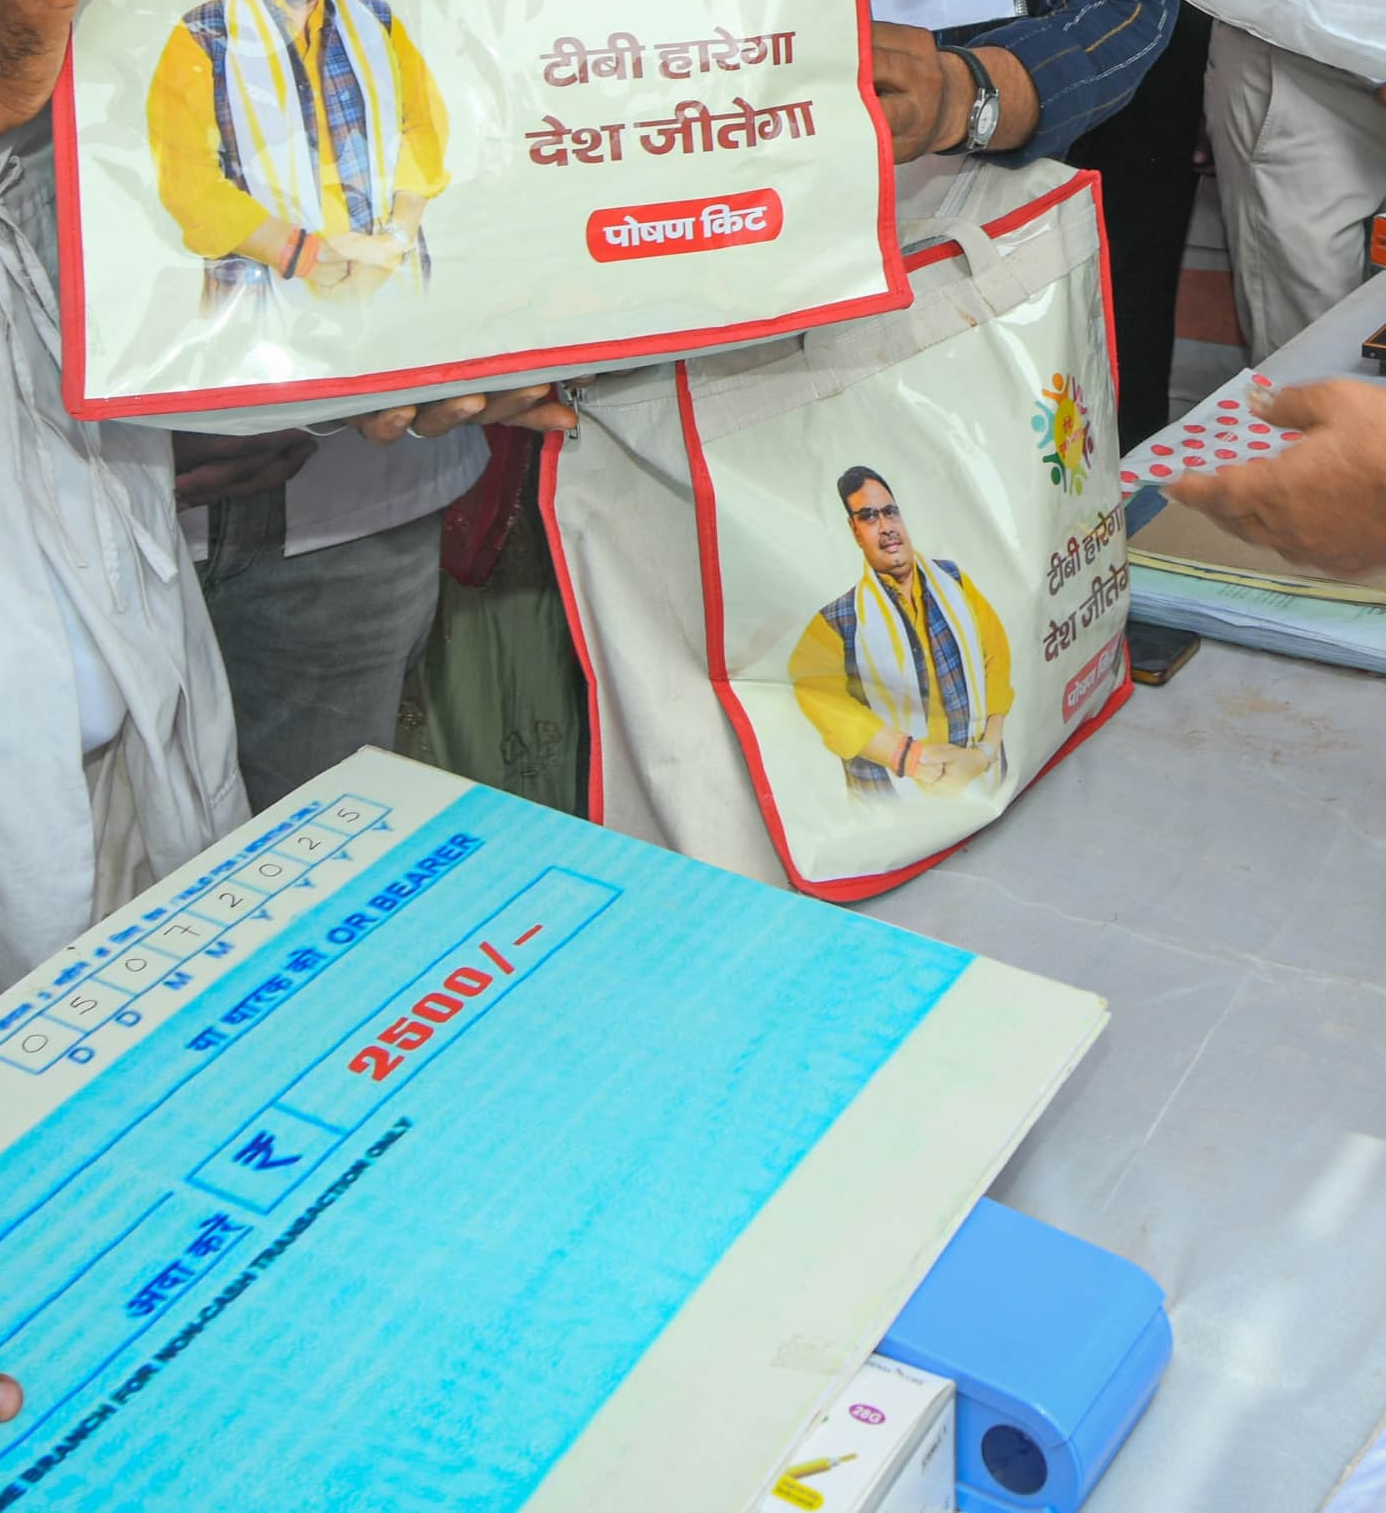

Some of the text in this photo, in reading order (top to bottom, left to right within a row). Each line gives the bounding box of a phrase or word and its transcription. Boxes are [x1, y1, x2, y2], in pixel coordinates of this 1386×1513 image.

[539, 26, 796, 87] टीबी हारेगा
[525, 97, 816, 166] देश जीतेगा
[603, 204, 768, 247] पोषण किट
[1047, 500, 1125, 596] टीबी हारेगा
[1043, 564, 1128, 662] देश जीतेग
[325, 911, 379, 946] OR
[369, 832, 481, 913] BEARER
[348, 924, 543, 1081] 2500/-
[20, 1403, 118, 1483] BRANCH
[111, 1362, 161, 1405] FOR
[153, 1272, 258, 1362] NON-CASH
[249, 1159, 371, 1270] TRANSACTION
[365, 1116, 413, 1159] ONLY
